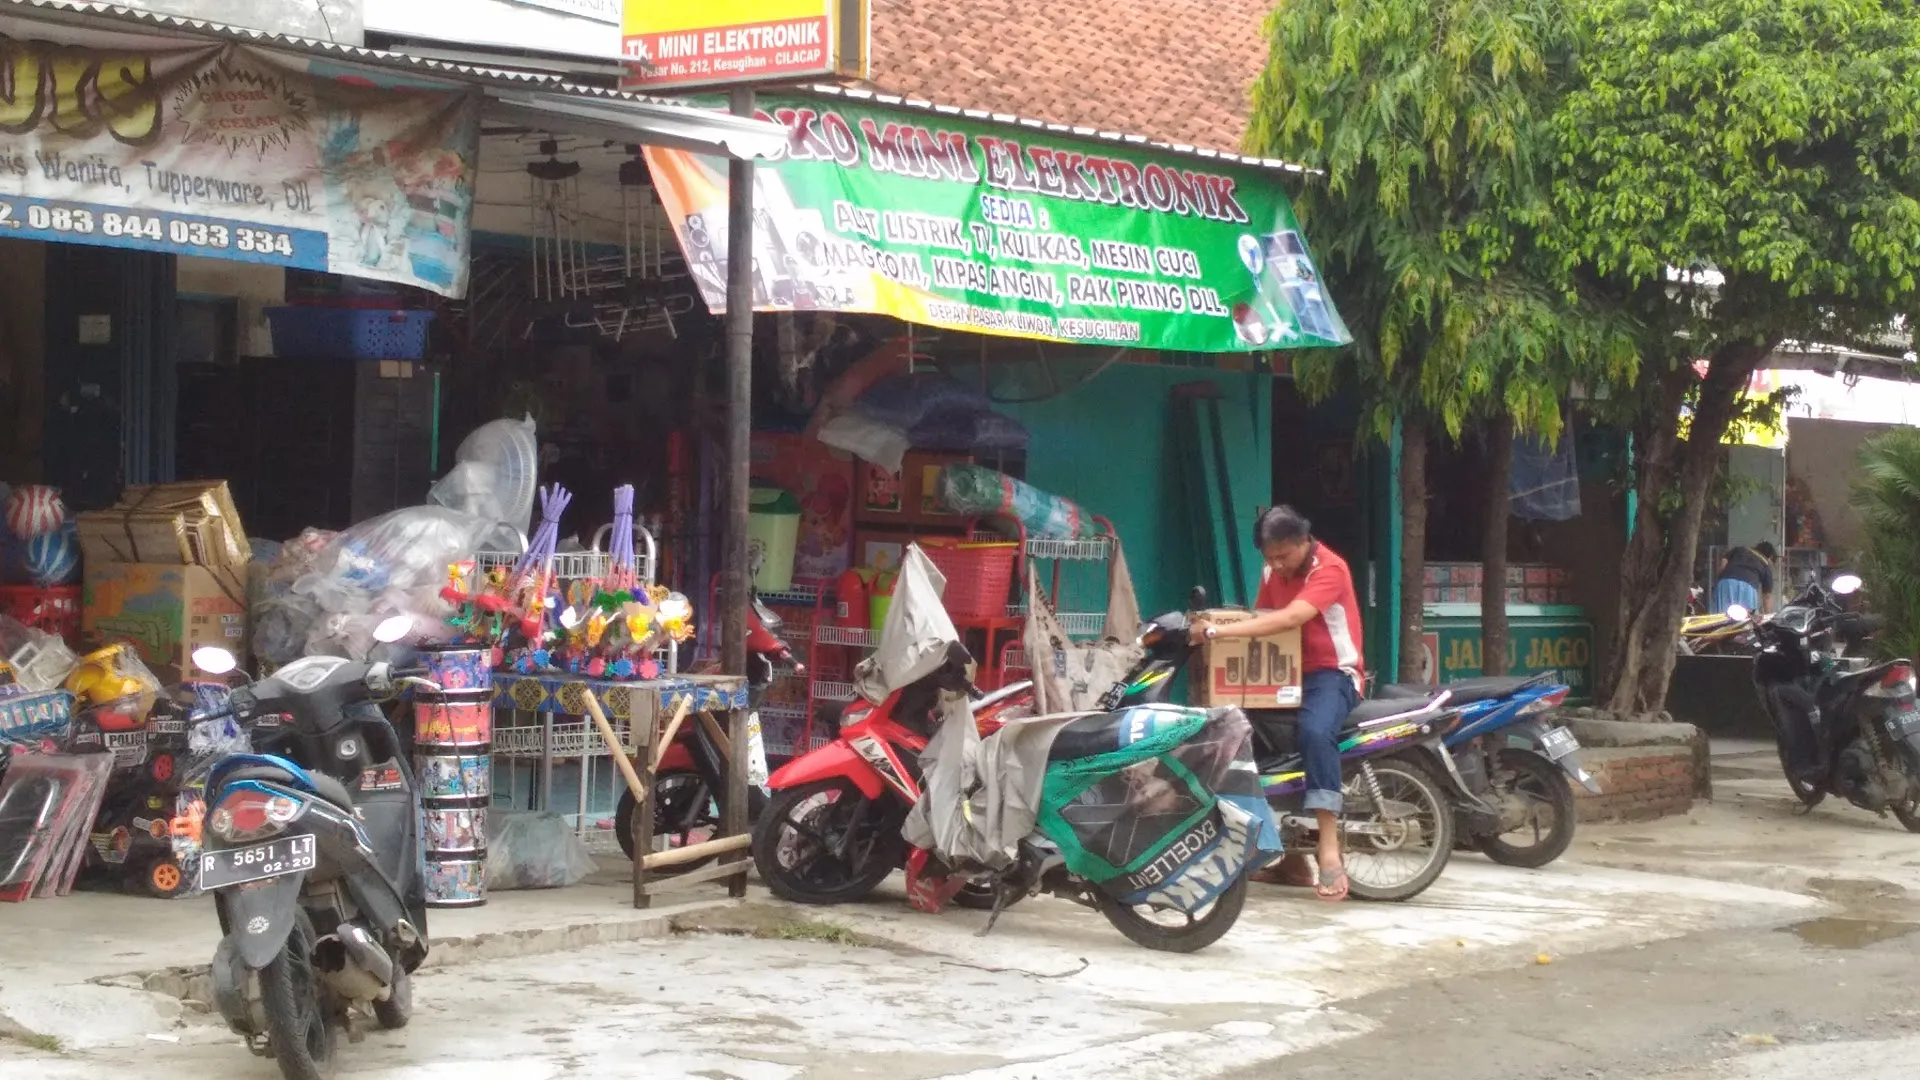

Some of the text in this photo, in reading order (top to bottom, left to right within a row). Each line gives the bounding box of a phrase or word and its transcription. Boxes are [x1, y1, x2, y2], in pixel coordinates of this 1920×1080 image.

[626, 20, 821, 60] Tk. MINI ELEKTRONIK
[670, 62, 688, 76] No.
[689, 59, 711, 75] 212,
[713, 54, 767, 72] Kesugihan
[774, 48, 821, 66] CILACAP
[199, 89, 269, 104] GROSIR
[207, 115, 281, 129] ECERAN
[34, 149, 131, 192] Wanita,
[140, 159, 274, 212] Tupperware,
[859, 117, 980, 183] MINI
[974, 136, 1250, 224] ELEKTRONIK
[27, 204, 94, 234] 083
[101, 211, 163, 241] 844
[168, 219, 230, 248] 033
[235, 226, 294, 257] 334
[979, 194, 1033, 228] SEDIA
[836, 203, 1199, 277] ALAT LISTRIK, TV, KULKAS, MESIN CUCI
[822, 240, 929, 288] MAGCOM,
[1069, 275, 1113, 304] RAK
[1117, 280, 1183, 310] PIRING
[1188, 287, 1228, 314] DLL.
[928, 302, 1141, 340] DEPAN PASAR KLIWON, KESUGIHAN
[1524, 637, 1590, 670] JAGO
[204, 837, 313, 872] R 5651 LT
[1127, 819, 1218, 891] EXCELLENT
